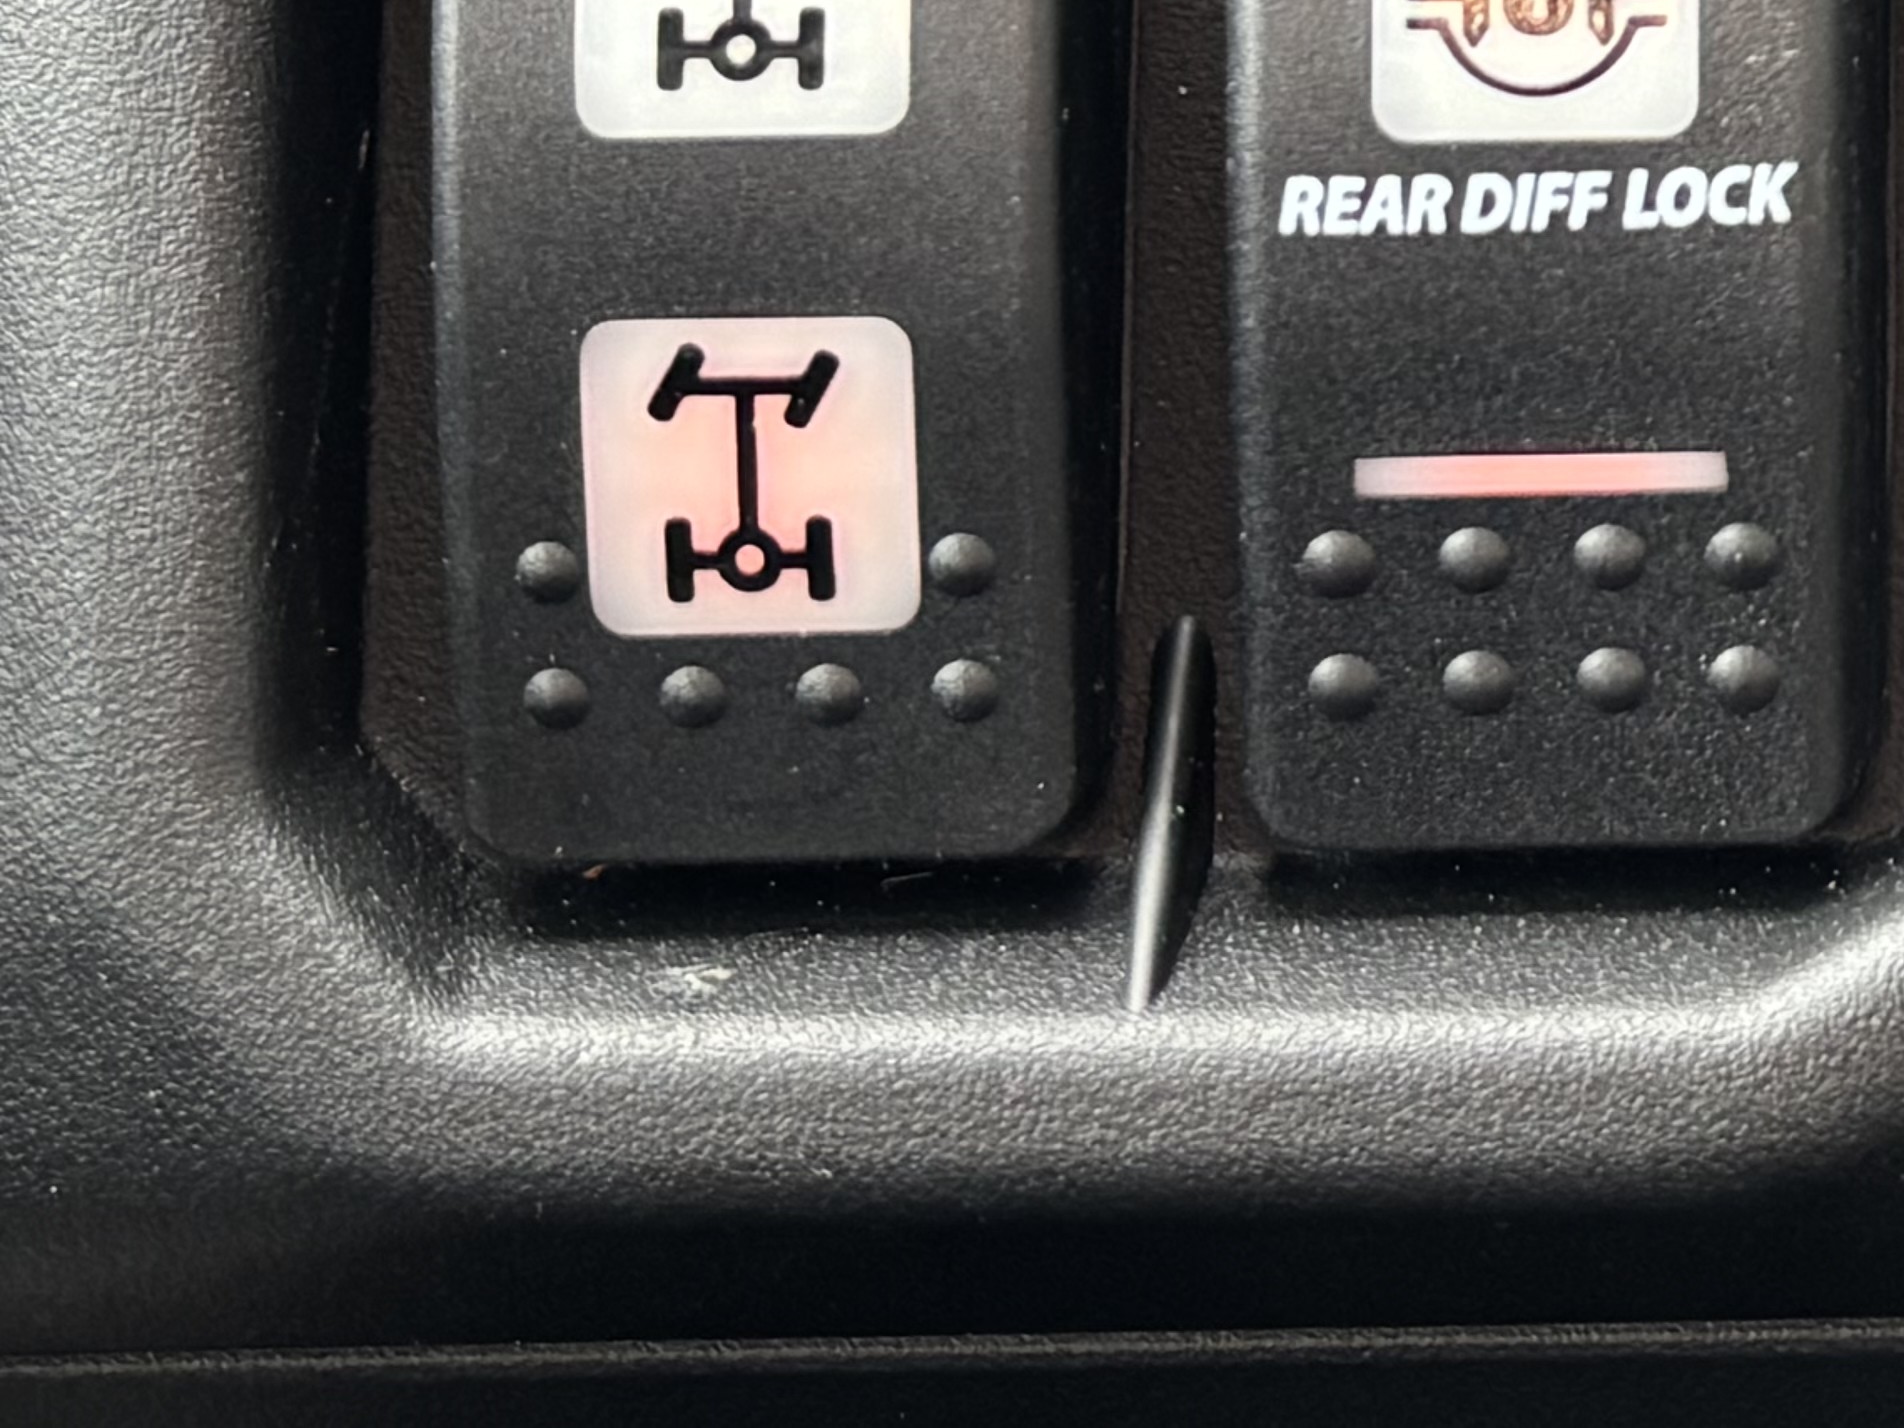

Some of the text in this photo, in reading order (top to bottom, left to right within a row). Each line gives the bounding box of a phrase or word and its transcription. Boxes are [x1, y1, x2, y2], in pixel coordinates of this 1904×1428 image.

[1278, 160, 1800, 236] REAR DIFF LOCK
